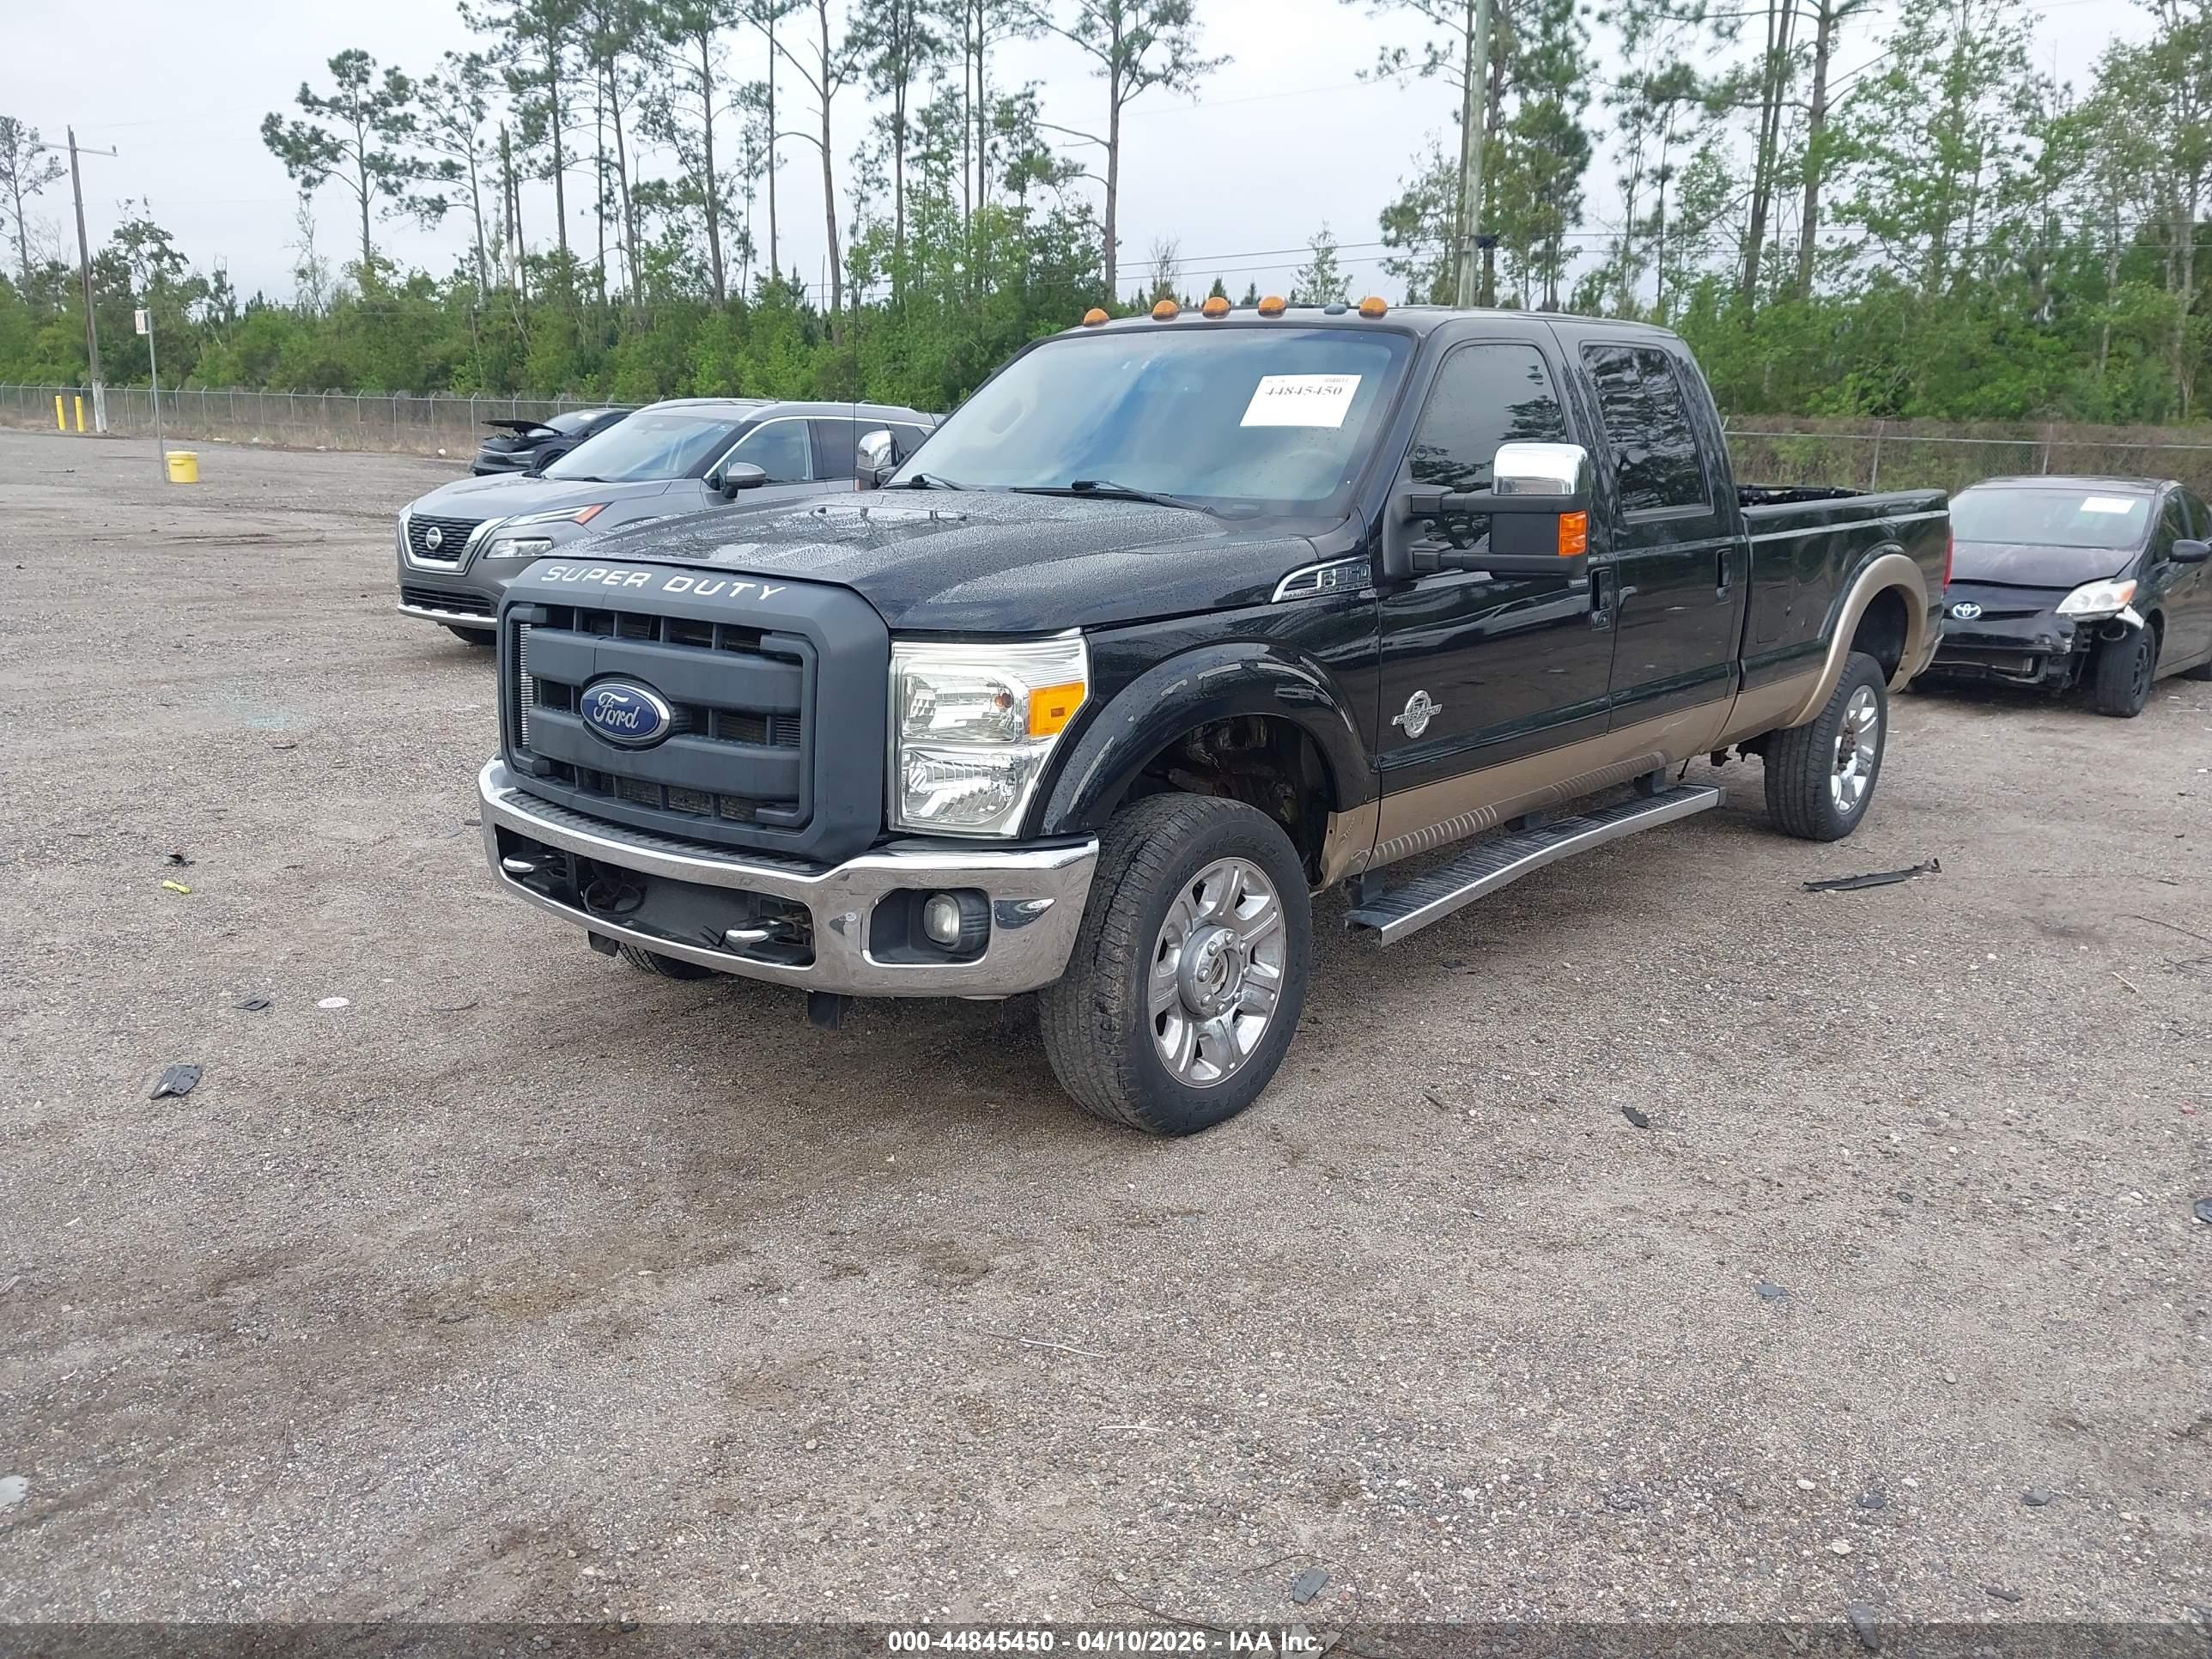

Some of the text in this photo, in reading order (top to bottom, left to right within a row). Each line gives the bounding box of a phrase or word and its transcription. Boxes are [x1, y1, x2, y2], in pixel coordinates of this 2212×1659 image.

[1265, 385, 1343, 396] 44845450
[540, 565, 787, 600] SUPER DUTY
[593, 691, 641, 729] Ford
